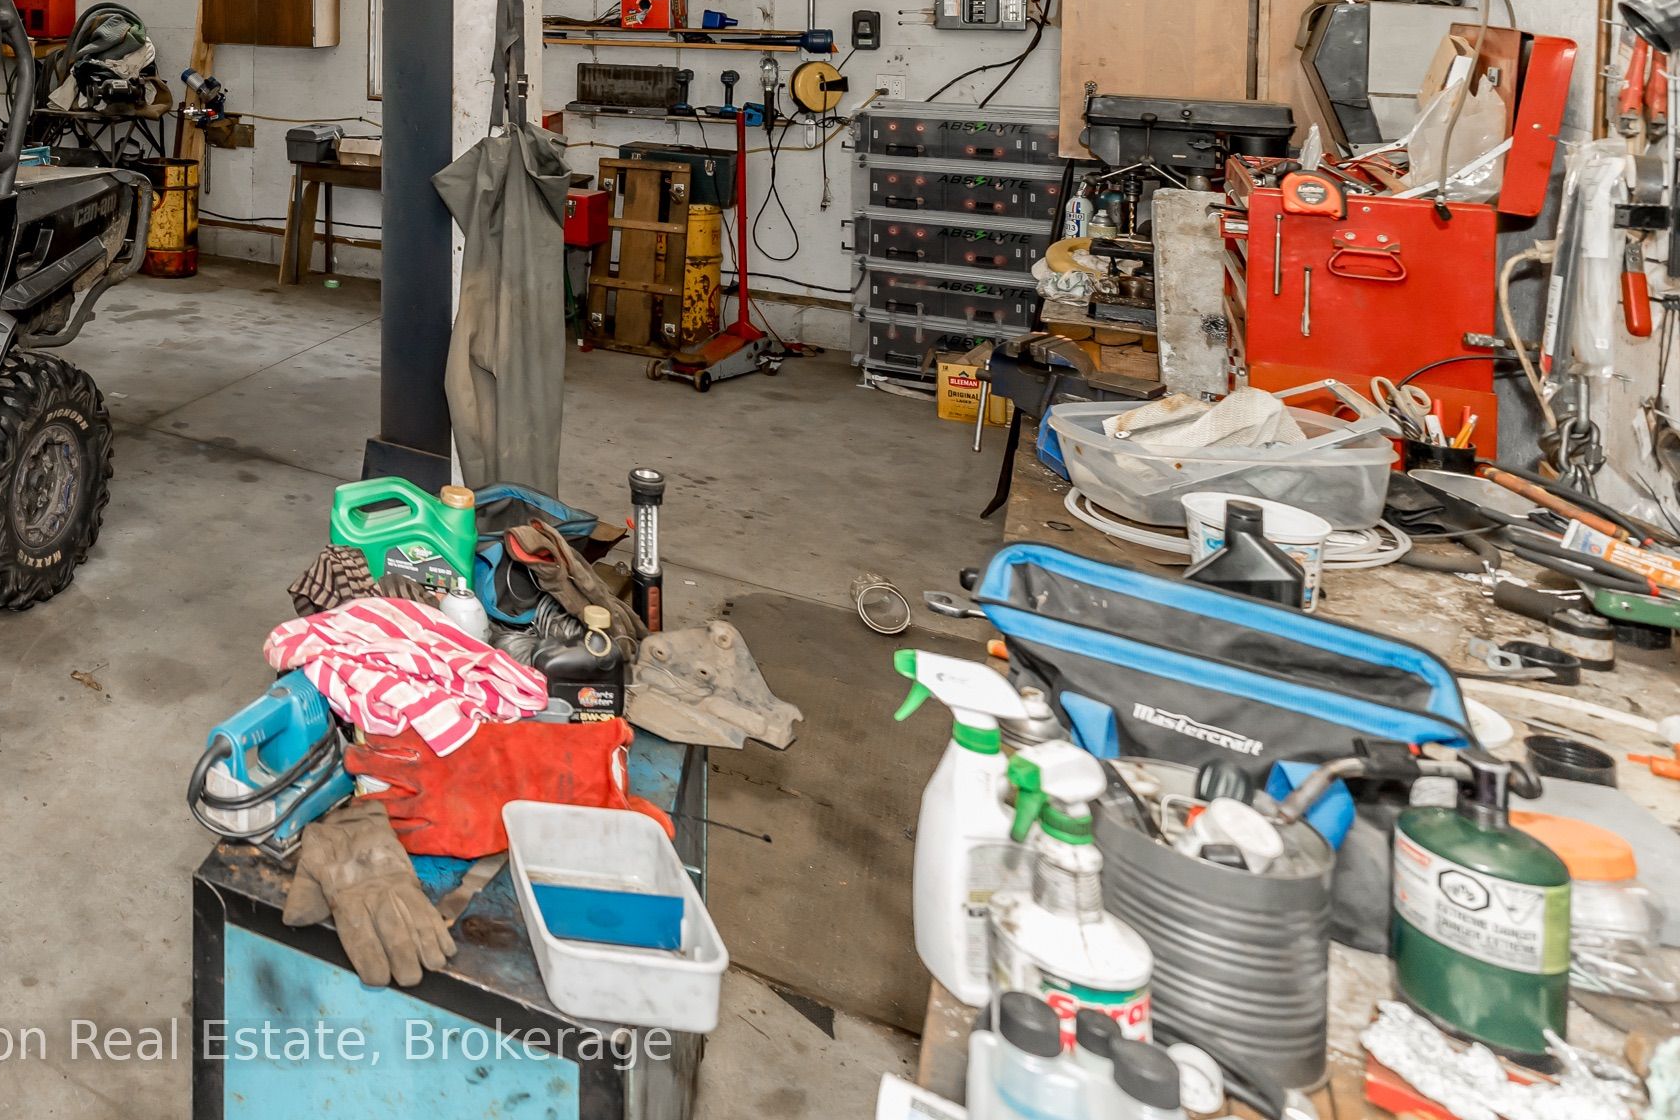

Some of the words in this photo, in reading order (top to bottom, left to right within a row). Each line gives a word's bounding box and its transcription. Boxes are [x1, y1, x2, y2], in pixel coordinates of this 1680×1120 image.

[74, 193, 117, 228] can-am
[950, 378, 978, 387] SLEEMAN
[45, 408, 89, 430] BIGHORN
[17, 549, 62, 568] MAXXIS
[1133, 702, 1264, 756] Mastercraft
